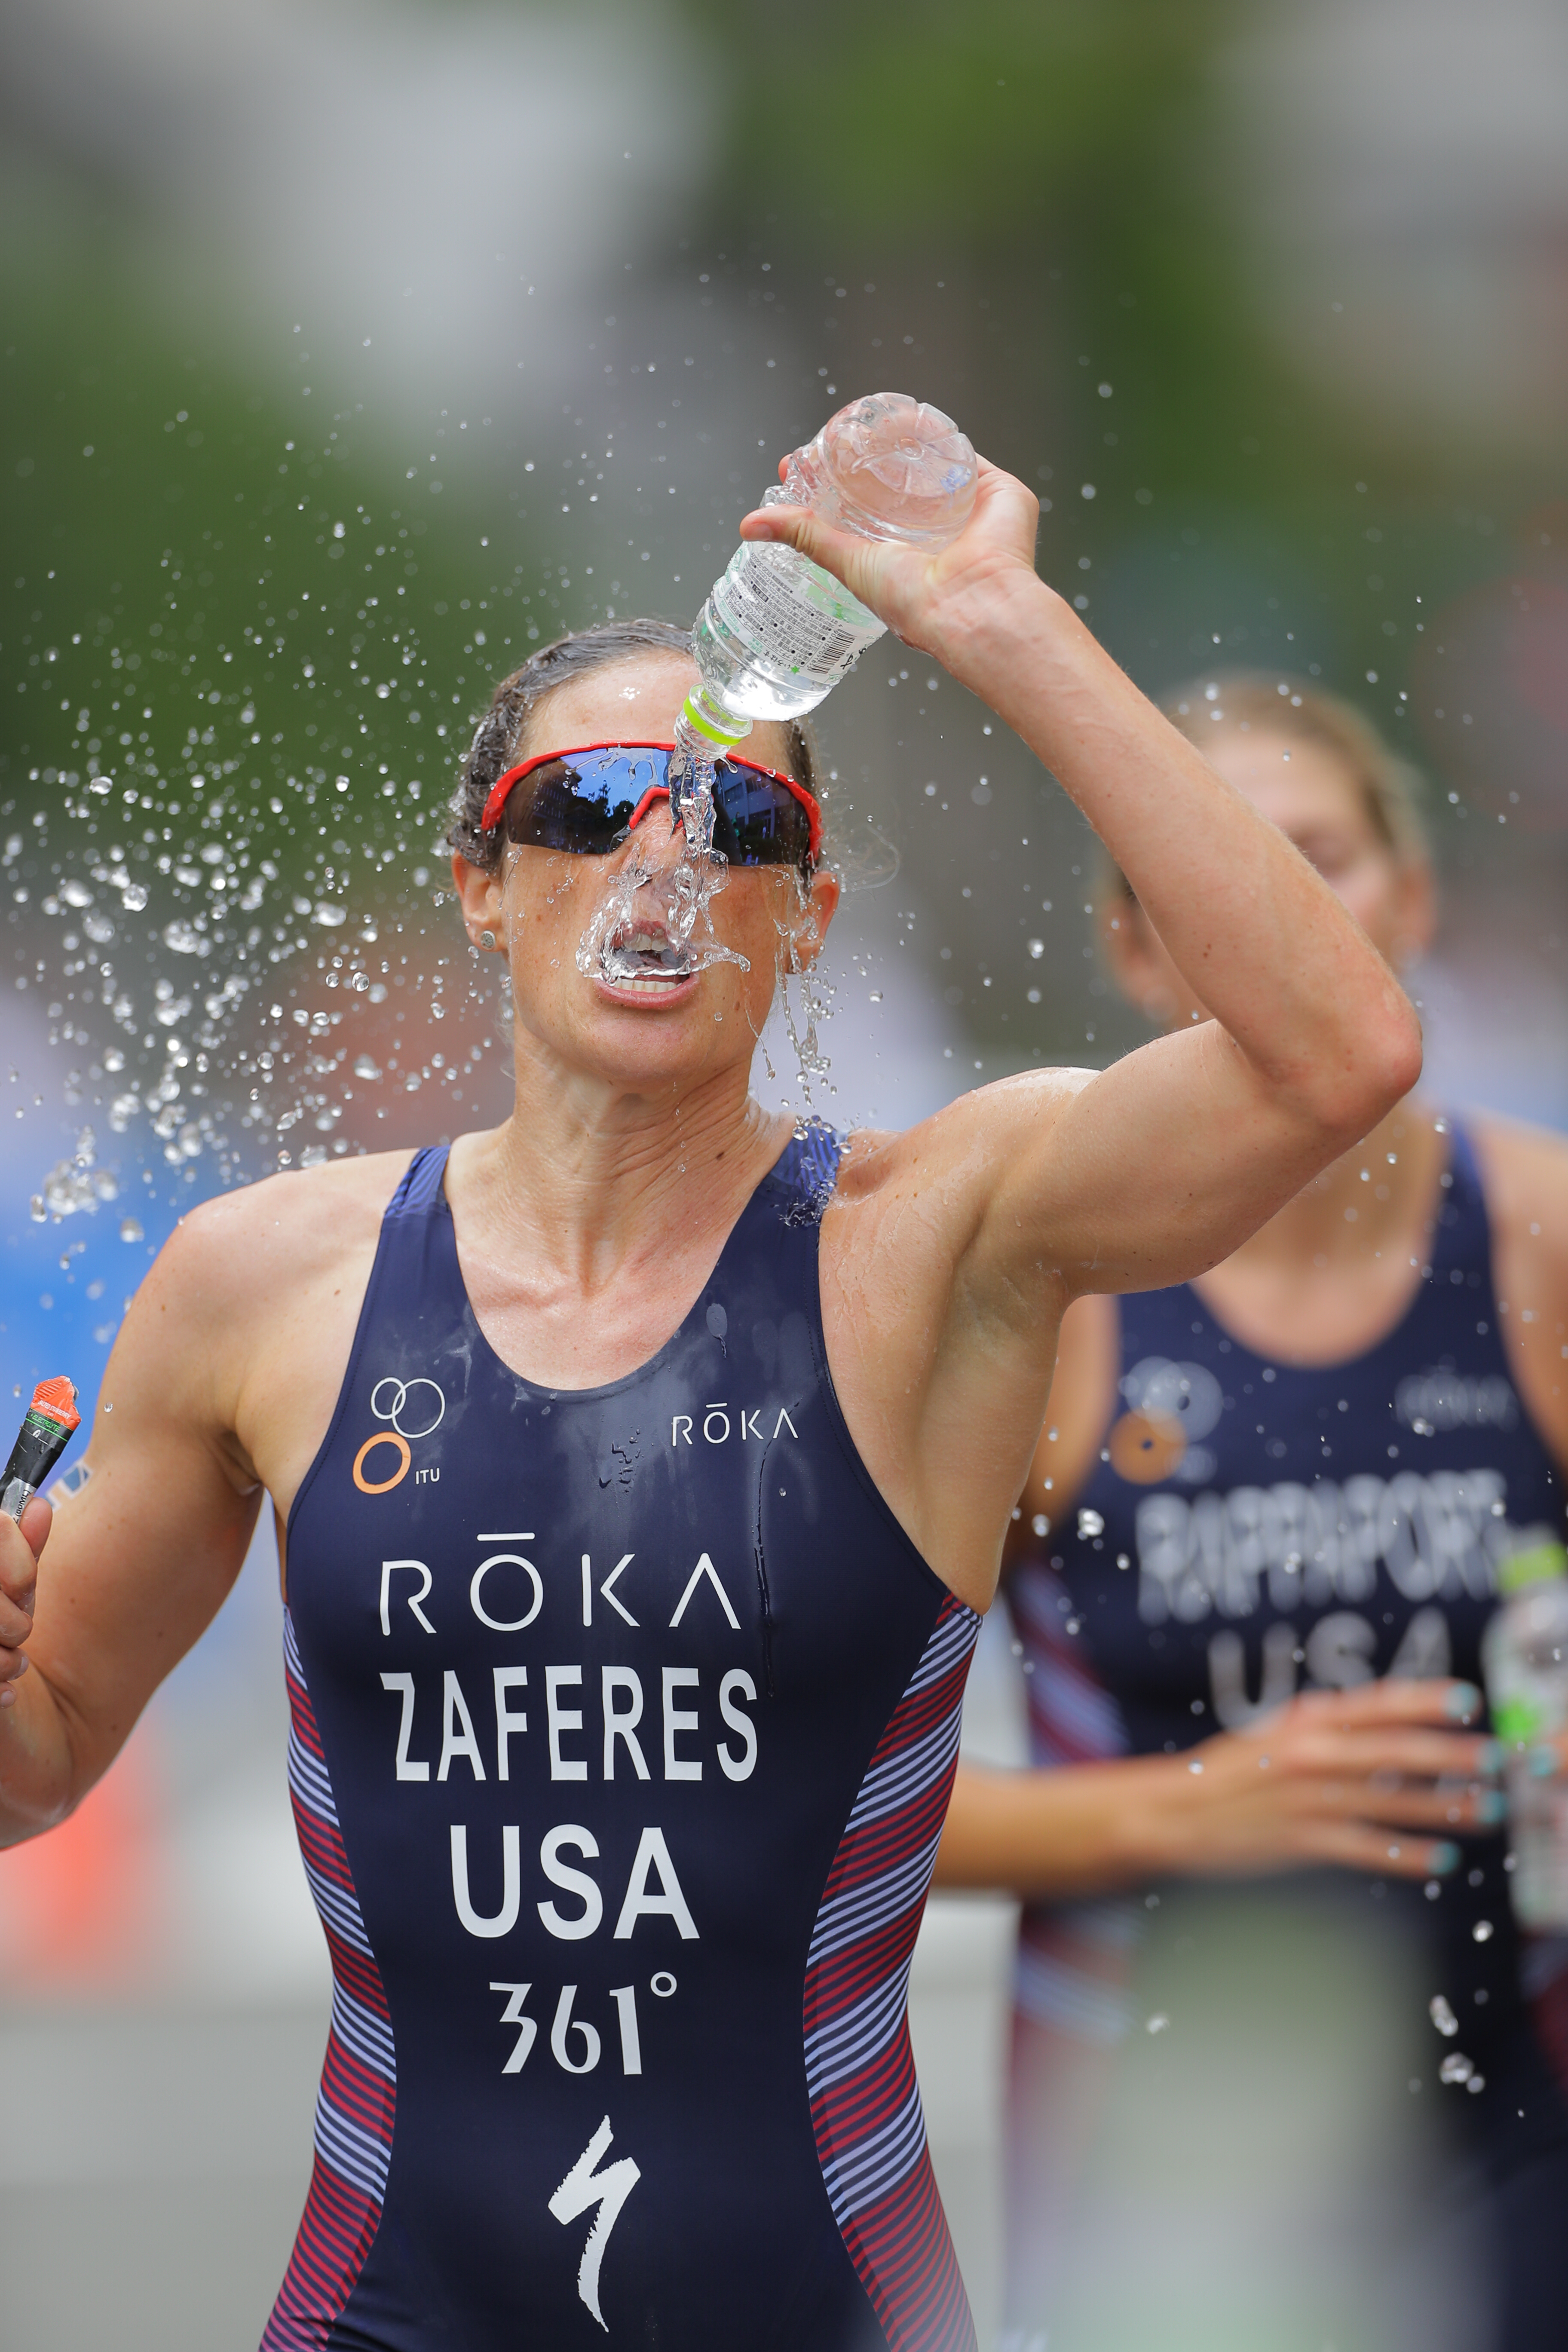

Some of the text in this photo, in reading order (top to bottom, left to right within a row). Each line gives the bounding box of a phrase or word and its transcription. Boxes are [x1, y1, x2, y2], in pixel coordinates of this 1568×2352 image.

[33, 1414, 60, 1431] ELECTROLYTE
[415, 1467, 440, 1485] ITU
[379, 1665, 758, 1782] ZAFERES
[450, 1824, 700, 1940] USA
